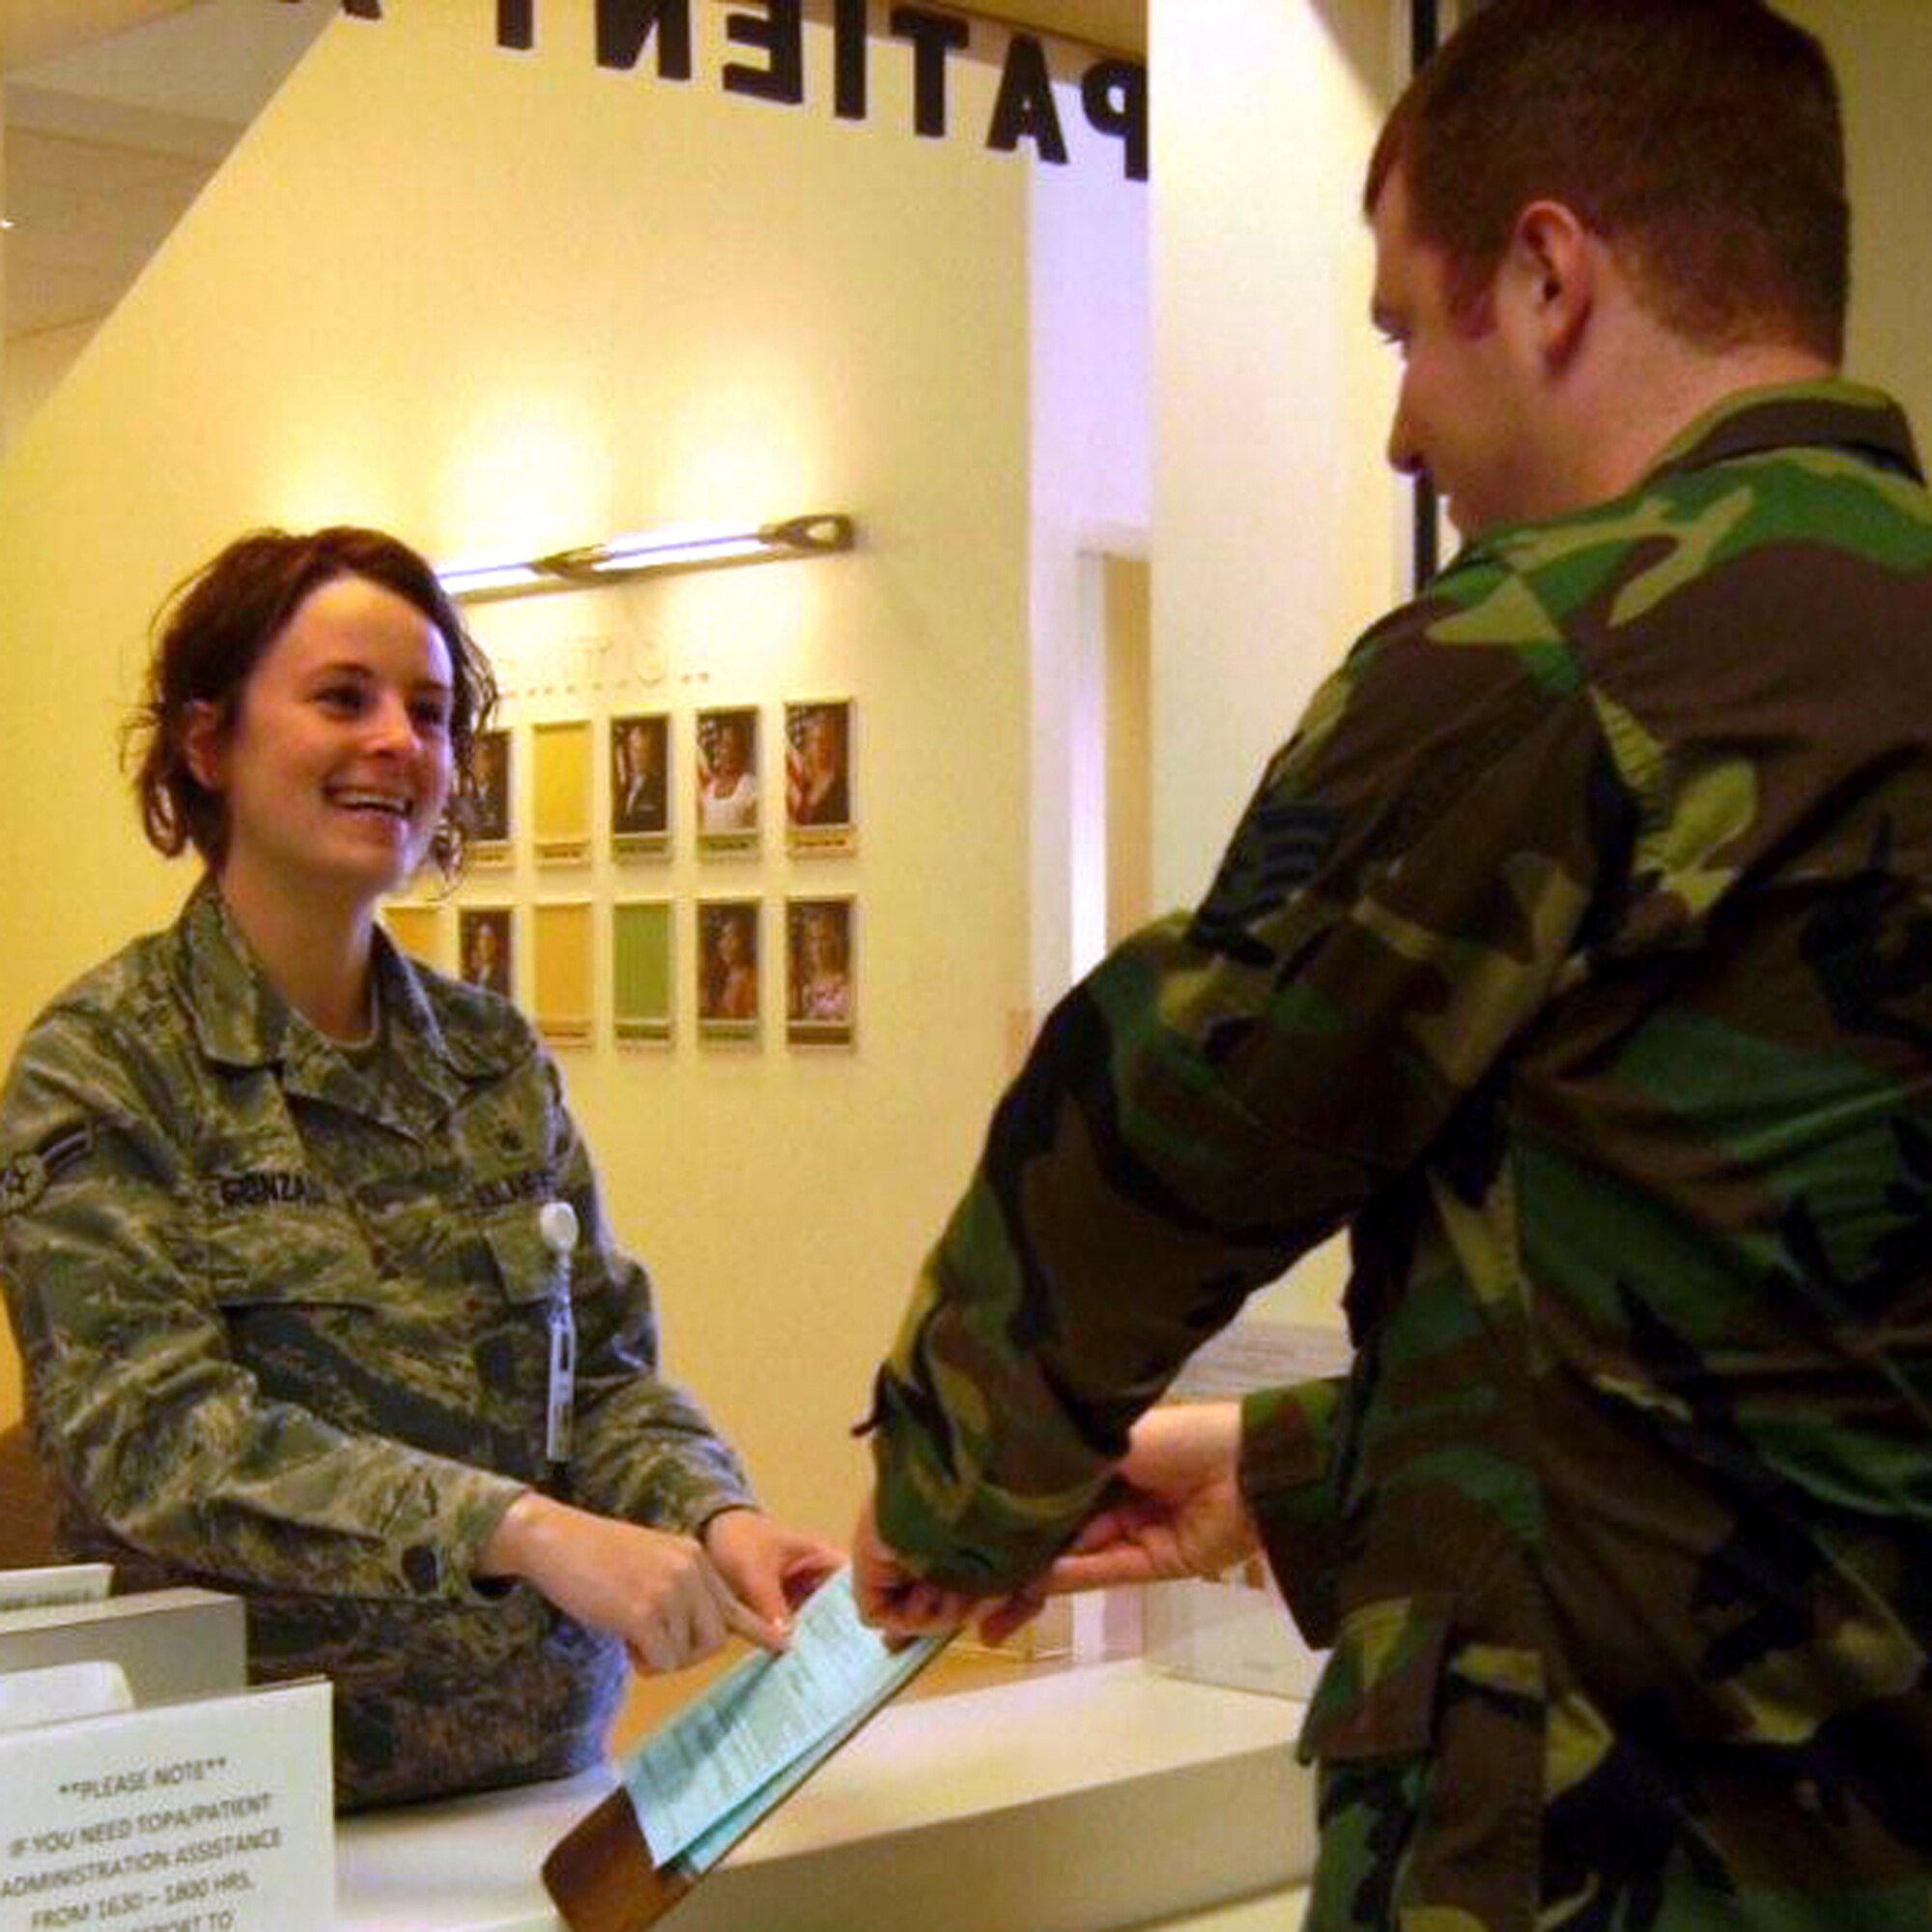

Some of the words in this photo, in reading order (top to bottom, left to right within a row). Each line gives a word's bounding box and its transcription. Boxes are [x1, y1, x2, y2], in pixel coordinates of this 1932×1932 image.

[32, 1830, 75, 1855] YOU
[80, 1817, 132, 1844] NEED
[1, 1849, 169, 1899] ADMINISTRATION
[175, 1826, 282, 1864] ASSISTANCE
[32, 1901, 91, 1929] FROM
[207, 1908, 235, 1932] TO
